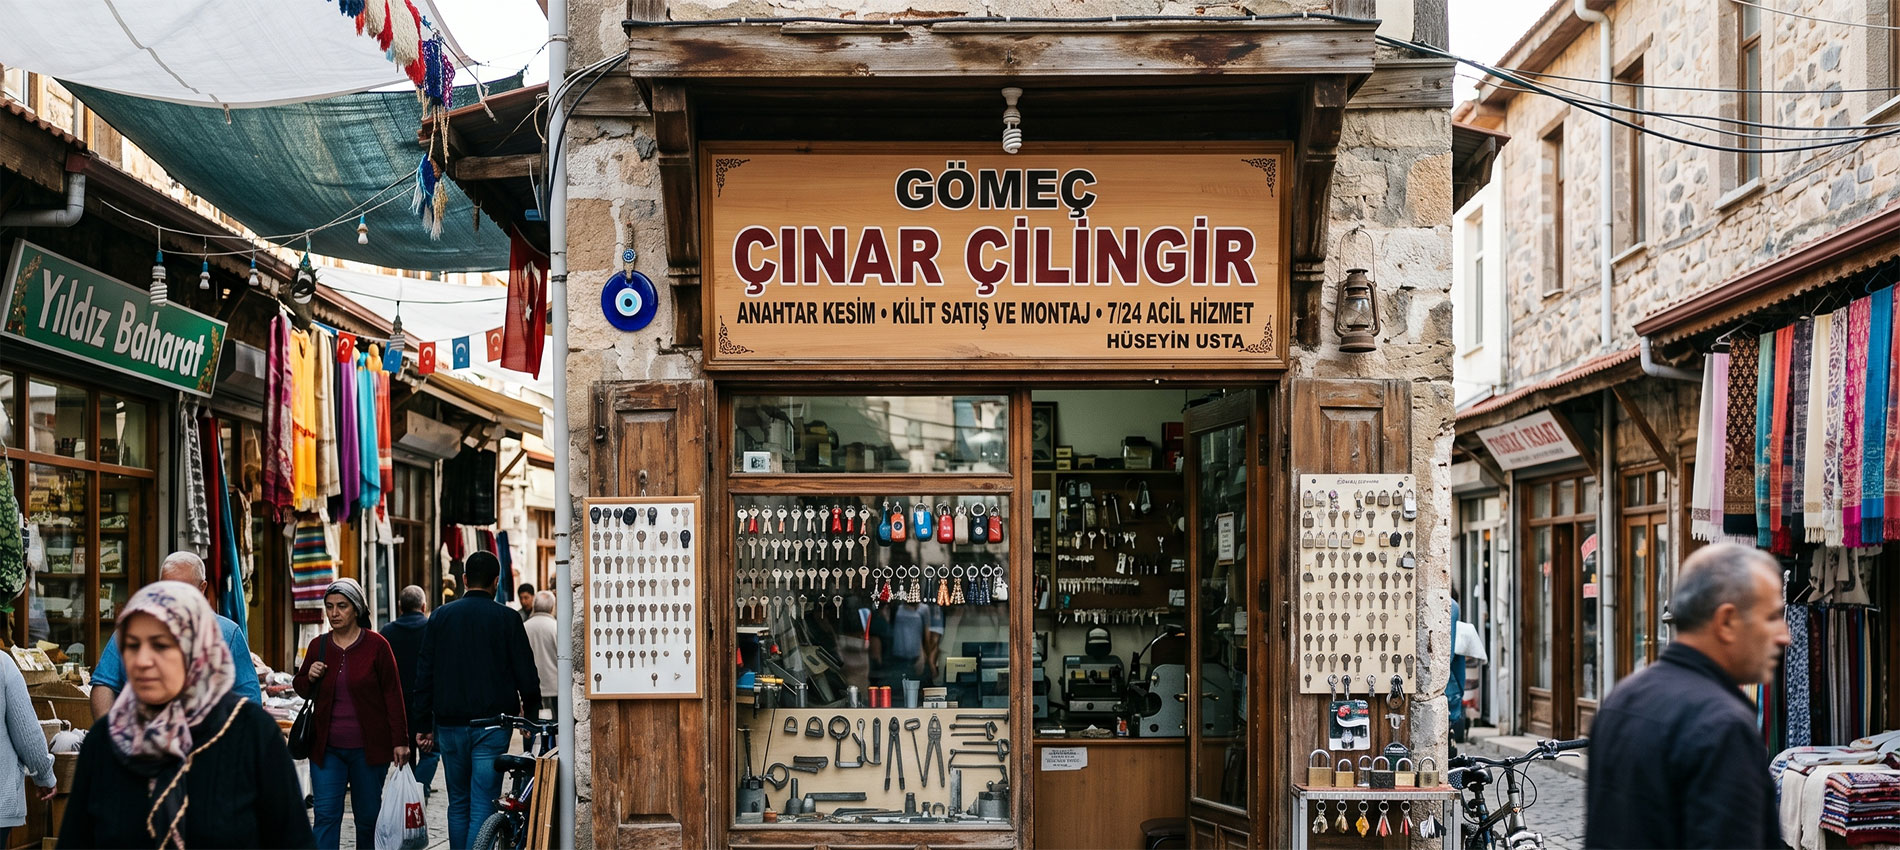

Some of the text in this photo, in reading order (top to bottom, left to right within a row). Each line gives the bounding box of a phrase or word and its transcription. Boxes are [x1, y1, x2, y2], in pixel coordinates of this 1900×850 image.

[896, 161, 1097, 218] GÖMEÇ
[734, 218, 1256, 296] ÇINAR ÇİLİNGİR
[38, 268, 205, 377] Yıldız Baharat
[737, 297, 1254, 330] ANAHTAR KESİM KİLİT SATIŞ VE MONTAJ 7/24 ACİL HİZMET
[1107, 331, 1245, 349] HÜSEYİN USTA
